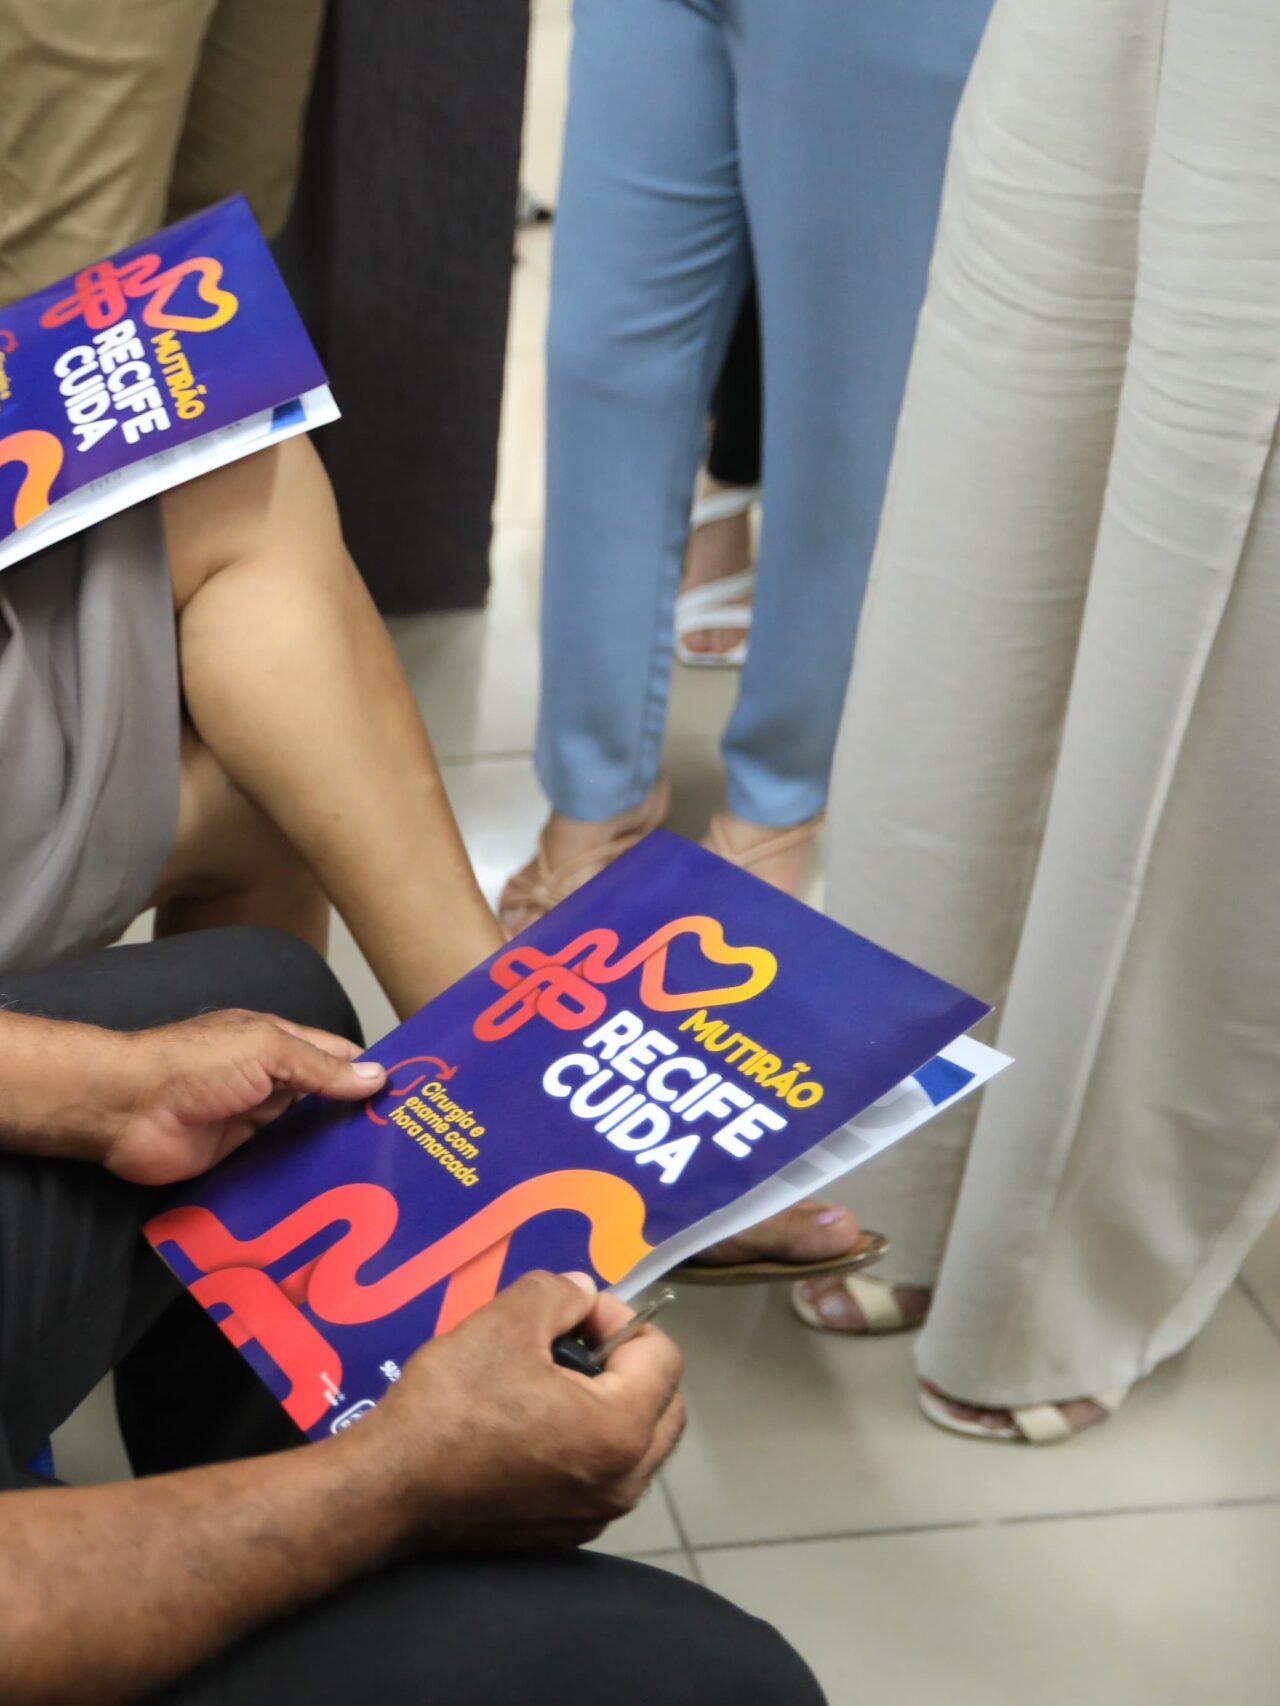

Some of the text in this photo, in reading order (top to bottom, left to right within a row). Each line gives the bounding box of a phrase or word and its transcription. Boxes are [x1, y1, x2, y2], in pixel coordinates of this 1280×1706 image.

[53, 345, 118, 452] CUIDA
[92, 318, 171, 444] RECIFE
[150, 329, 208, 420] MUTIRÃO
[582, 1009, 788, 1158] RECIFE
[678, 1009, 824, 1109] MUTIRÃO
[388, 1105, 479, 1186] hora marcada
[405, 1096, 479, 1159] exame com
[421, 1081, 485, 1138] Cirurgia e
[542, 1053, 701, 1184] CUIDA
